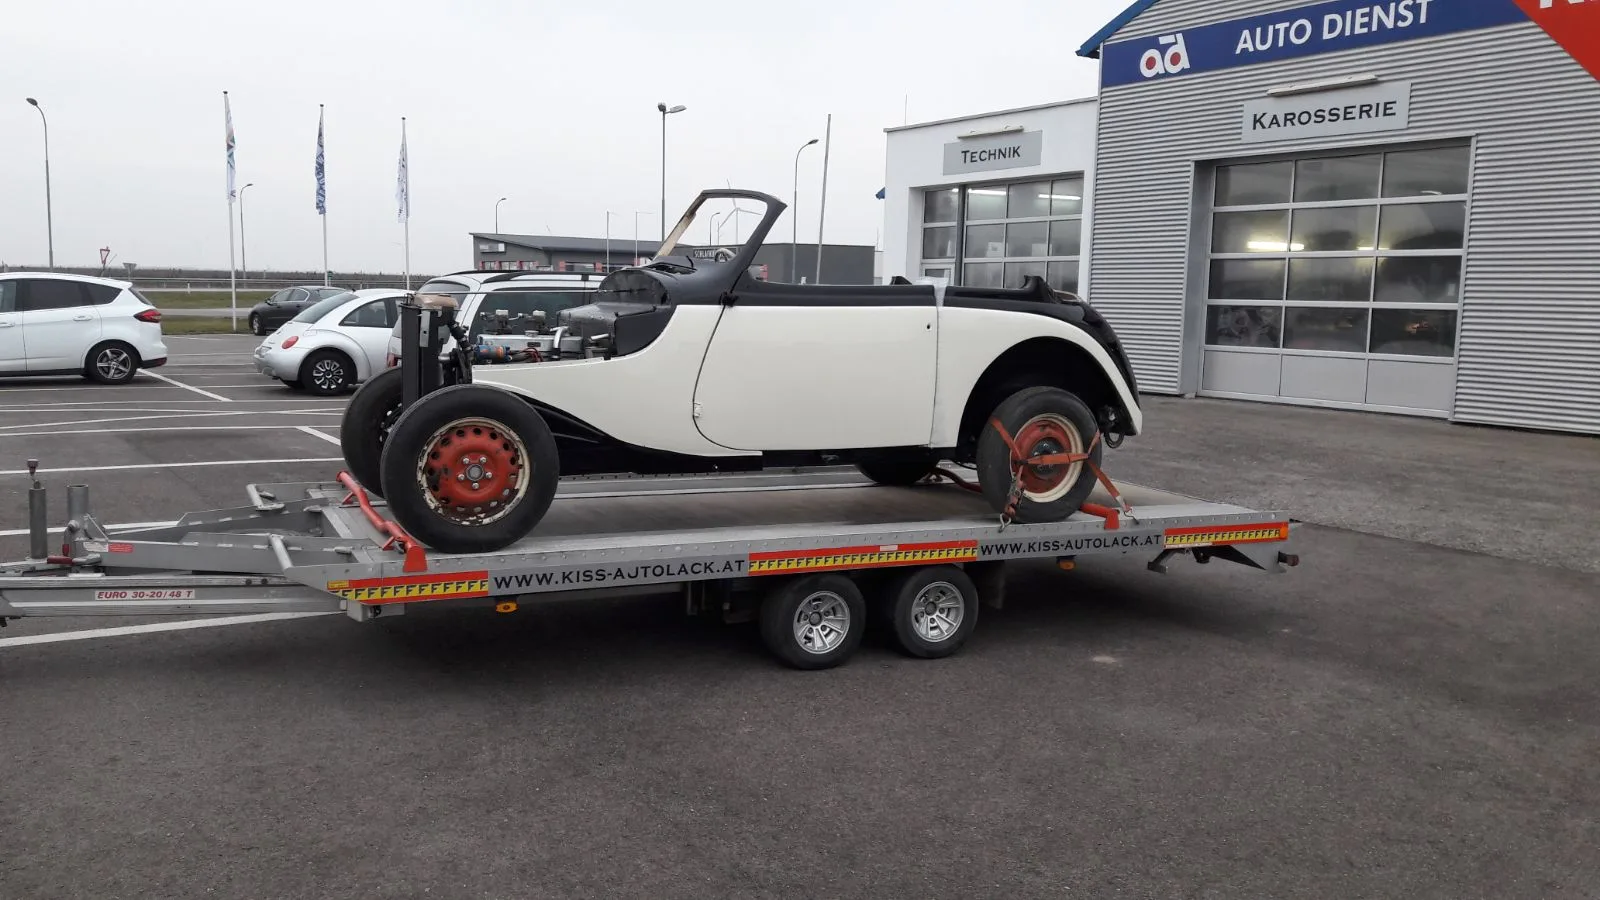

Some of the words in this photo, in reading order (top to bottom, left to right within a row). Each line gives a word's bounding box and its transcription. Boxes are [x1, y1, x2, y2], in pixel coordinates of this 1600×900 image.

[1235, 18, 1312, 55] AUTO
[1322, 0, 1431, 41] DIENST
[98, 591, 128, 599] EURO
[185, 590, 193, 598] T
